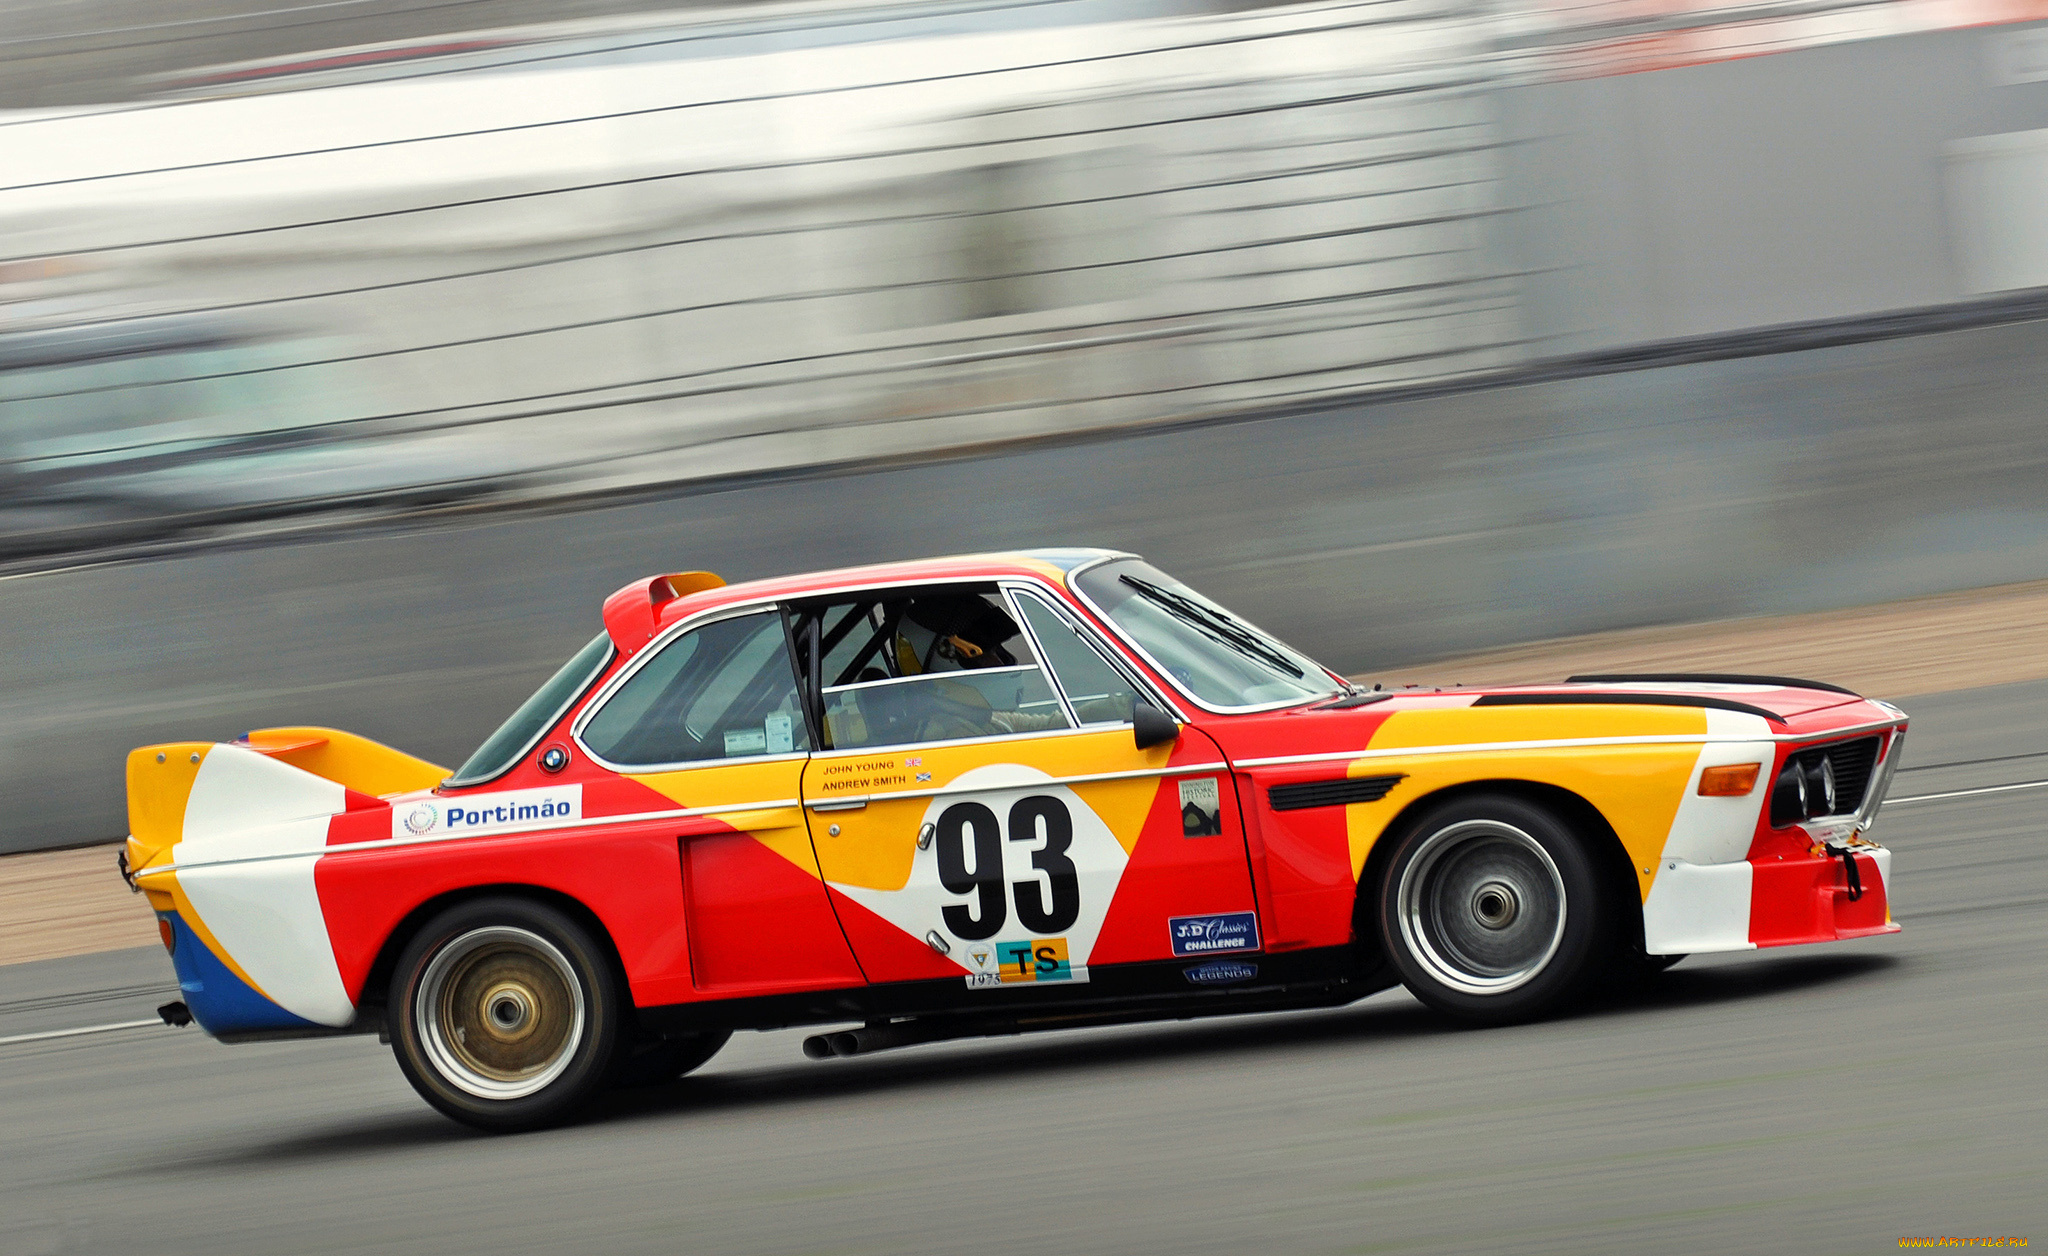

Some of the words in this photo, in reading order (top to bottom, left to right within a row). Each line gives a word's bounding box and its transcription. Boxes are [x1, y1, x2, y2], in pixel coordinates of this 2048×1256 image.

[823, 763, 853, 776] JOHN
[856, 761, 895, 772] YOUNG
[822, 779, 870, 792] ANDREW
[873, 775, 906, 787] SMITH
[447, 798, 571, 828] Portimão
[935, 794, 1080, 941] 93
[1185, 938, 1245, 951] CHALLENGE
[1009, 946, 1059, 976] TS
[971, 972, 1001, 987] 1975
[1191, 969, 1252, 981] LEGENDS
